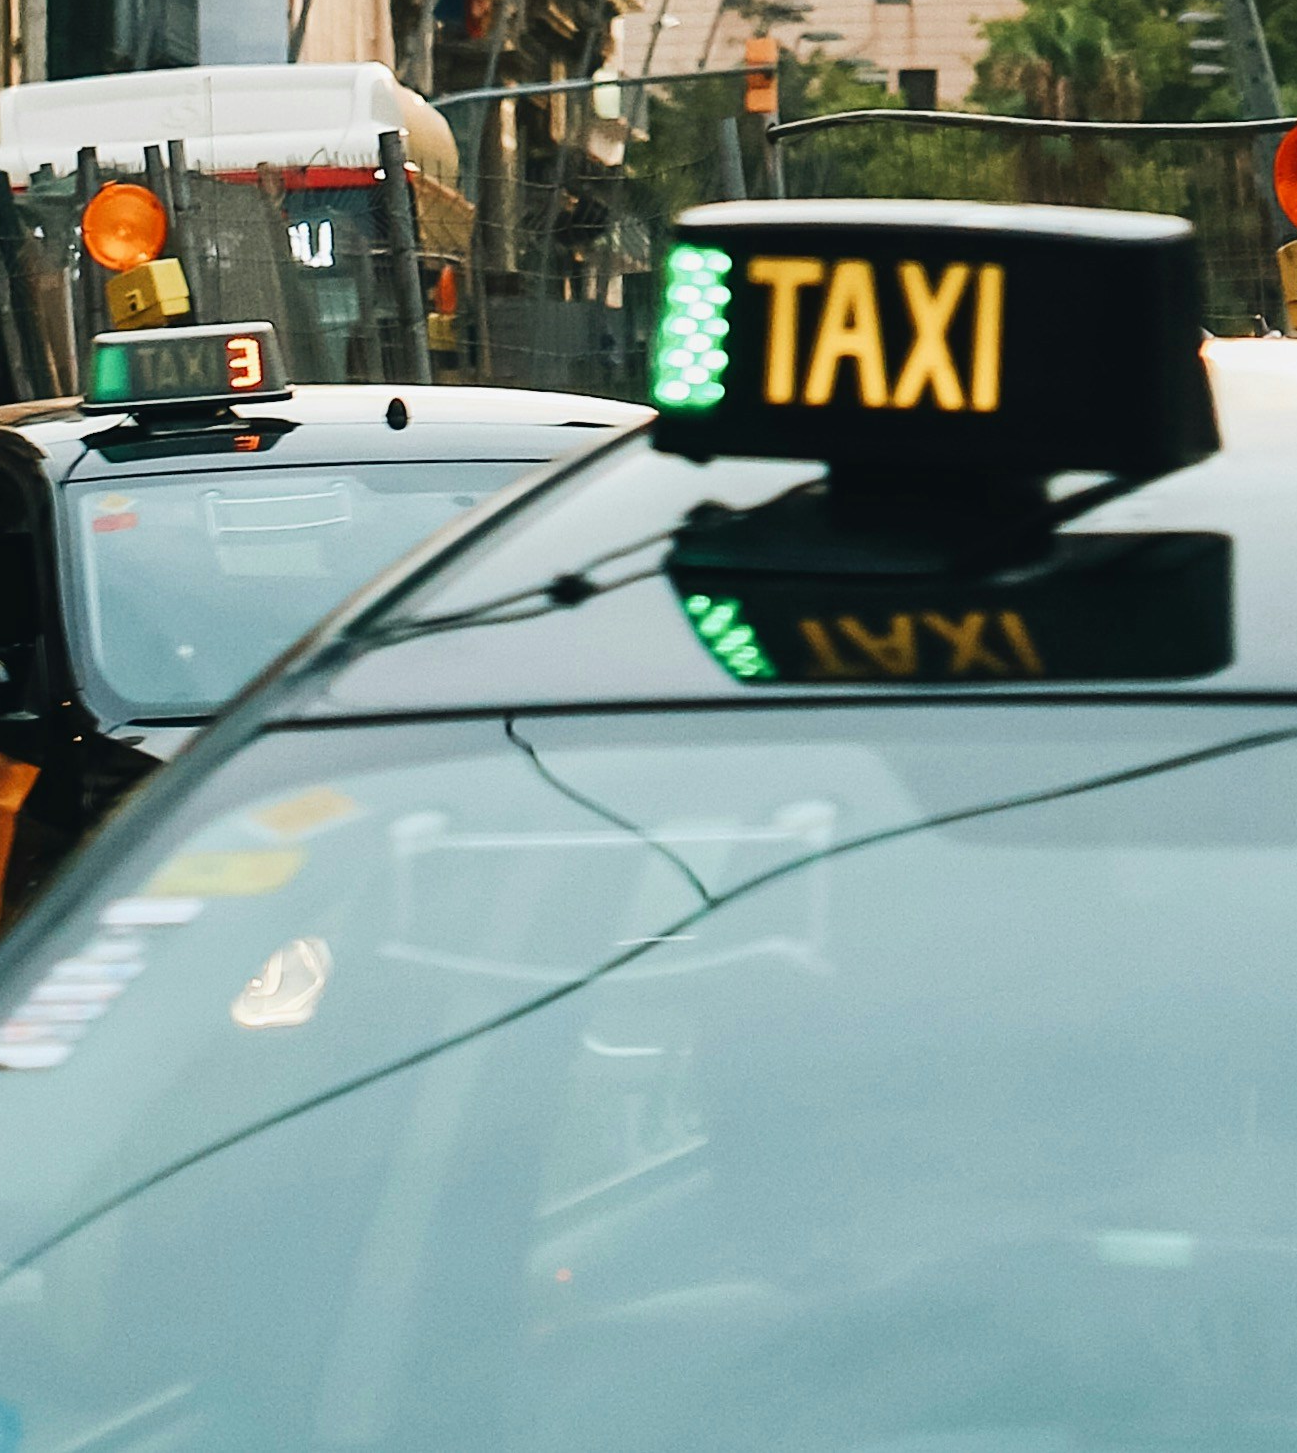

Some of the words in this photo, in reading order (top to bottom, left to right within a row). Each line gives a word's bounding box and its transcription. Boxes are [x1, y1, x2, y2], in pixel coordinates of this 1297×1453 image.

[136, 345, 220, 391] TAXI
[226, 336, 263, 389] 3
[748, 256, 1003, 412] TAXI
